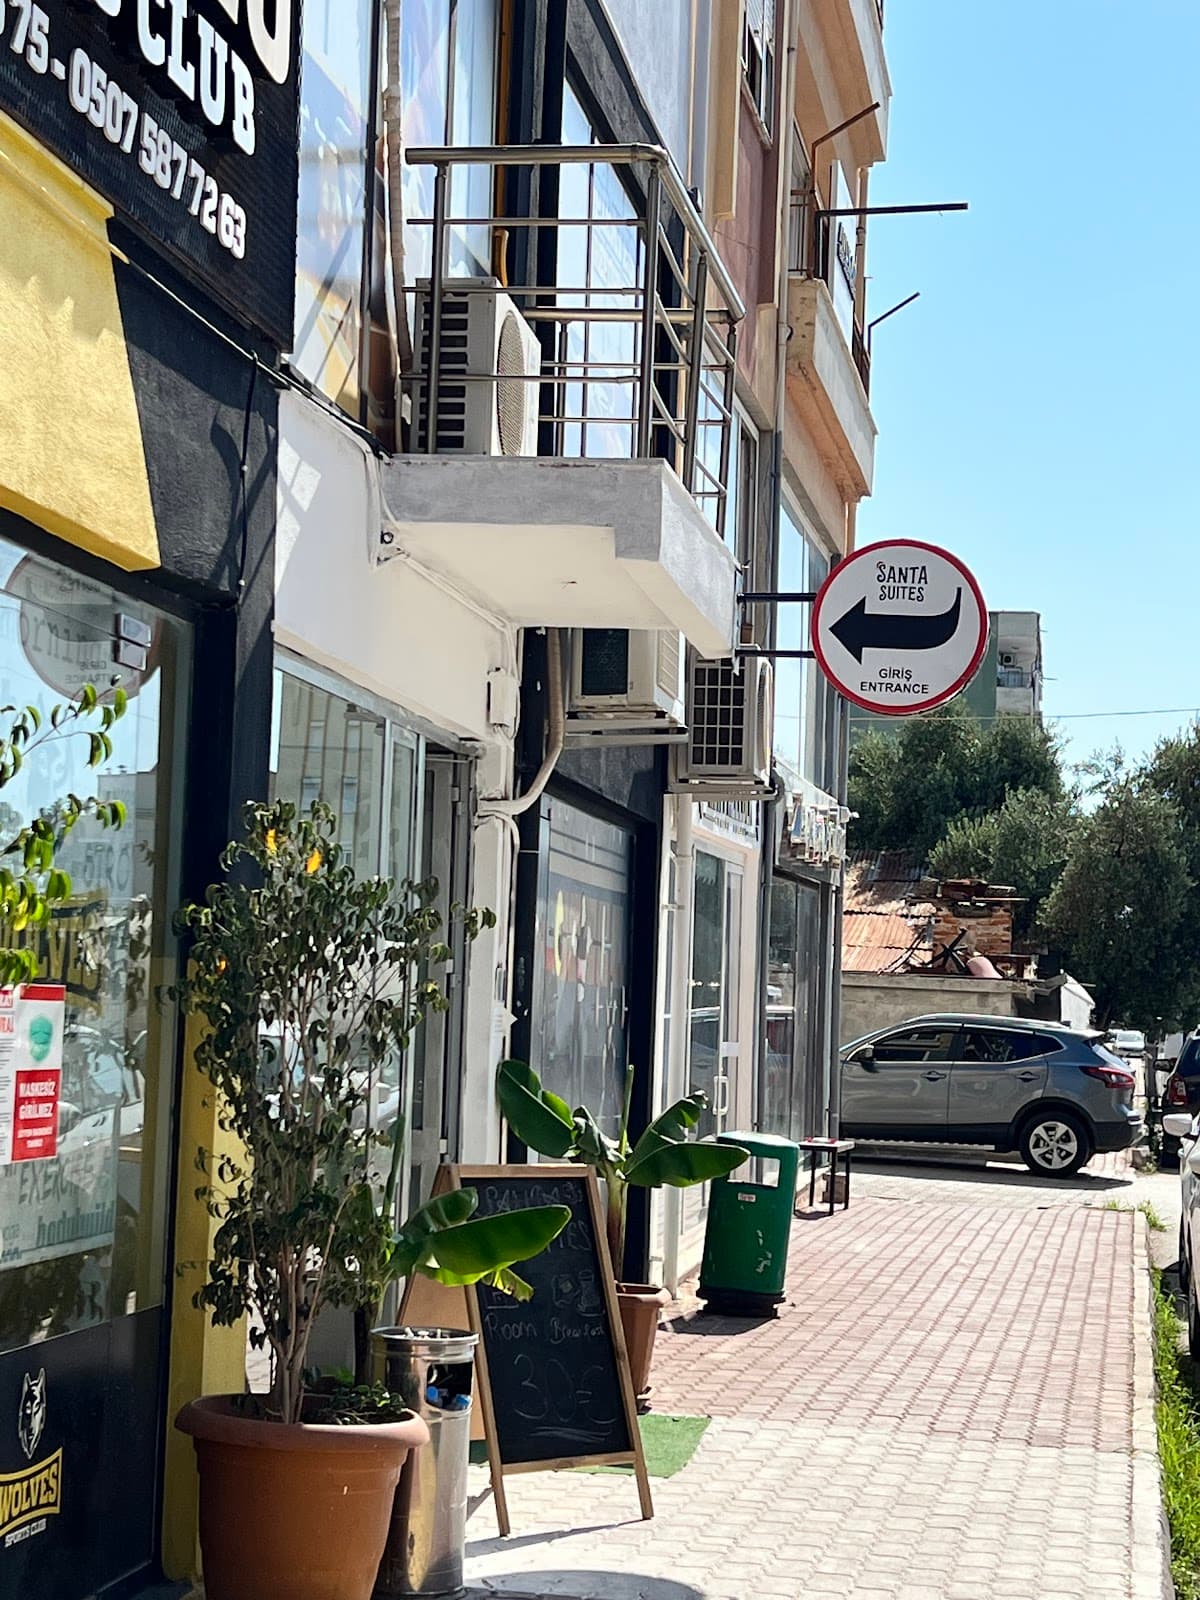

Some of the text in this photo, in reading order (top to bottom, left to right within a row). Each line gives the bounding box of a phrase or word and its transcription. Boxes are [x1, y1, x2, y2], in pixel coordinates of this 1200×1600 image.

[137, 0, 255, 156] CLUB
[876, 561, 928, 585] SANTA
[879, 585, 925, 602] SUITES
[878, 667, 913, 682] GİRİŞ
[860, 681, 929, 694] ENTRANCE
[0, 1463, 58, 1527] WOLVES
